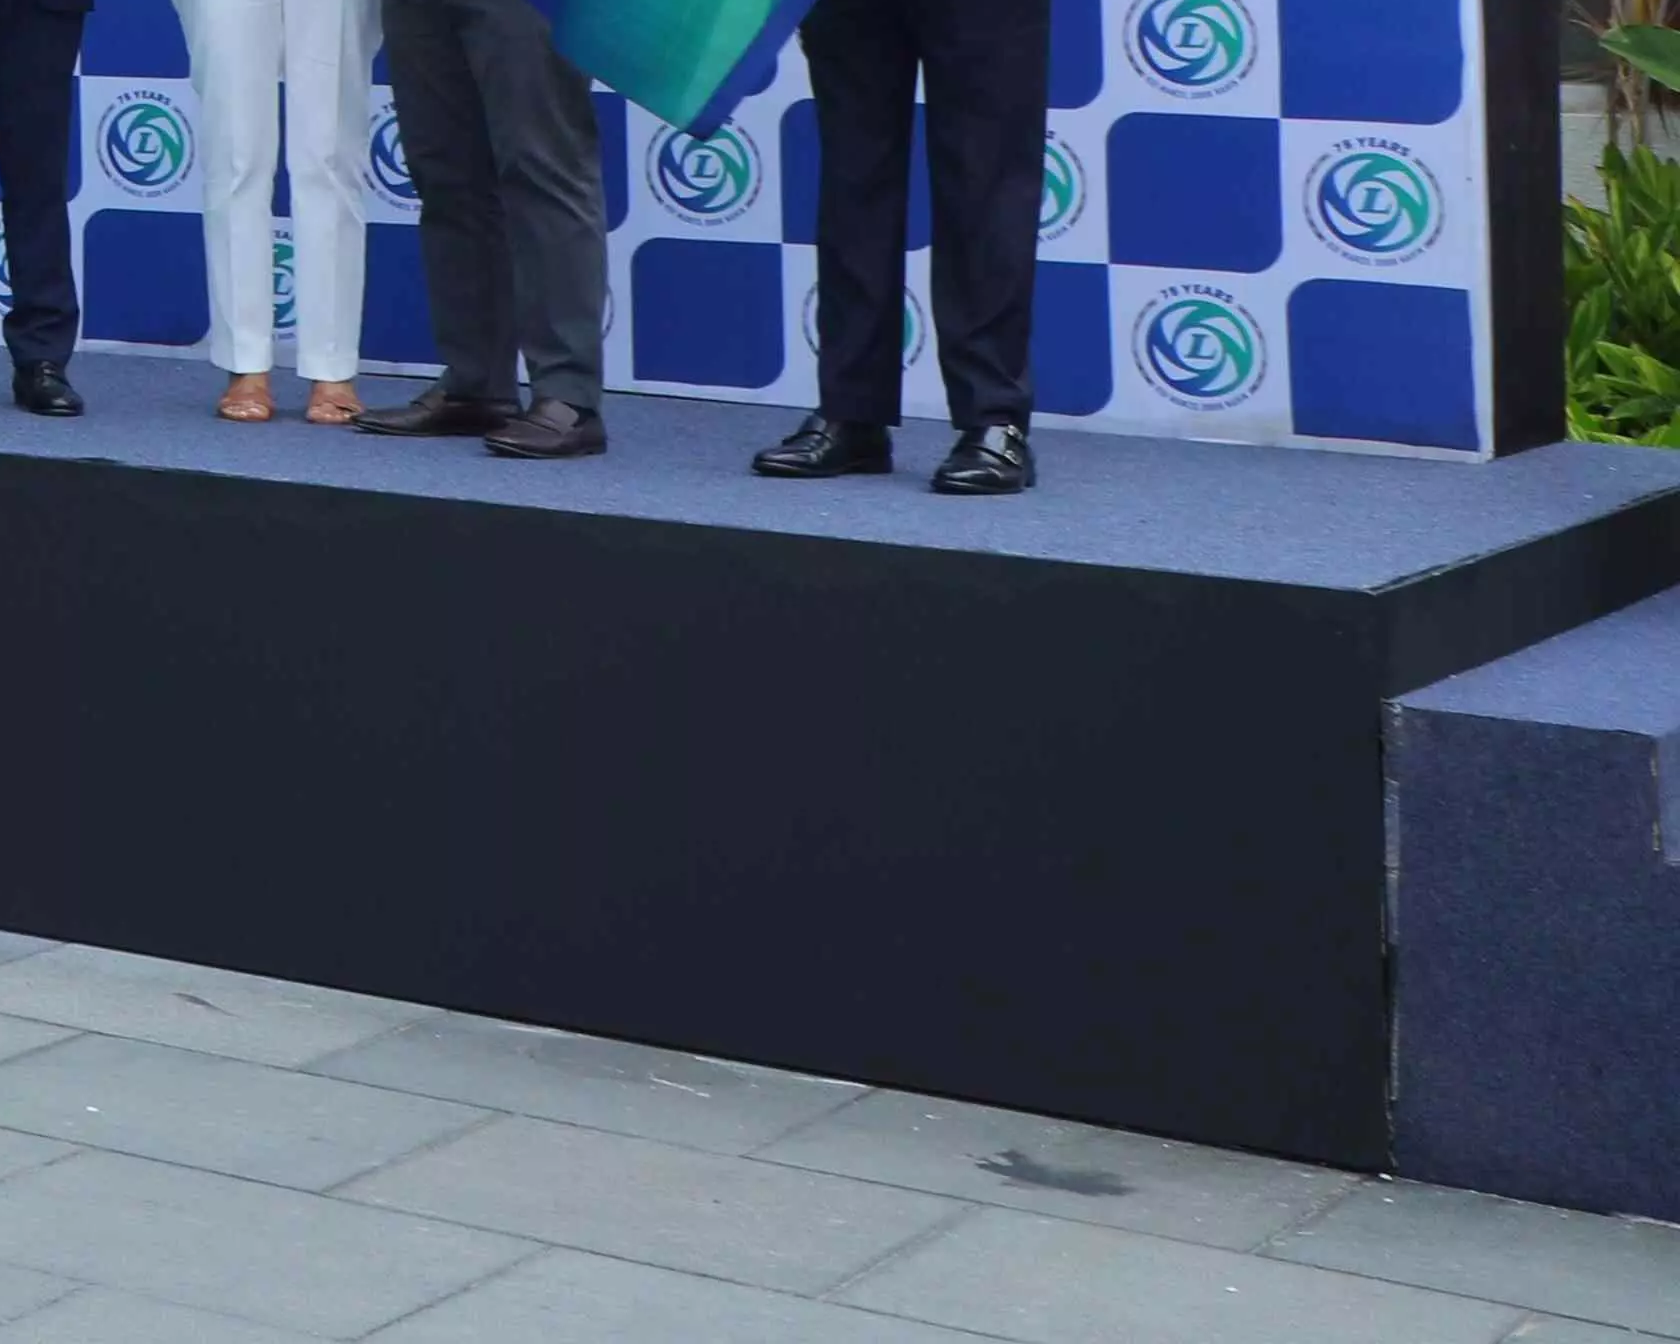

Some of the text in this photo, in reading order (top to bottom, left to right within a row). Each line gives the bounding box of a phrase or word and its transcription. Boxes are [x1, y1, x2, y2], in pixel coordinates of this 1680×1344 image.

[135, 90, 171, 105] YEARS
[1357, 137, 1410, 155] YEARS
[1181, 284, 1234, 303] YEARS
